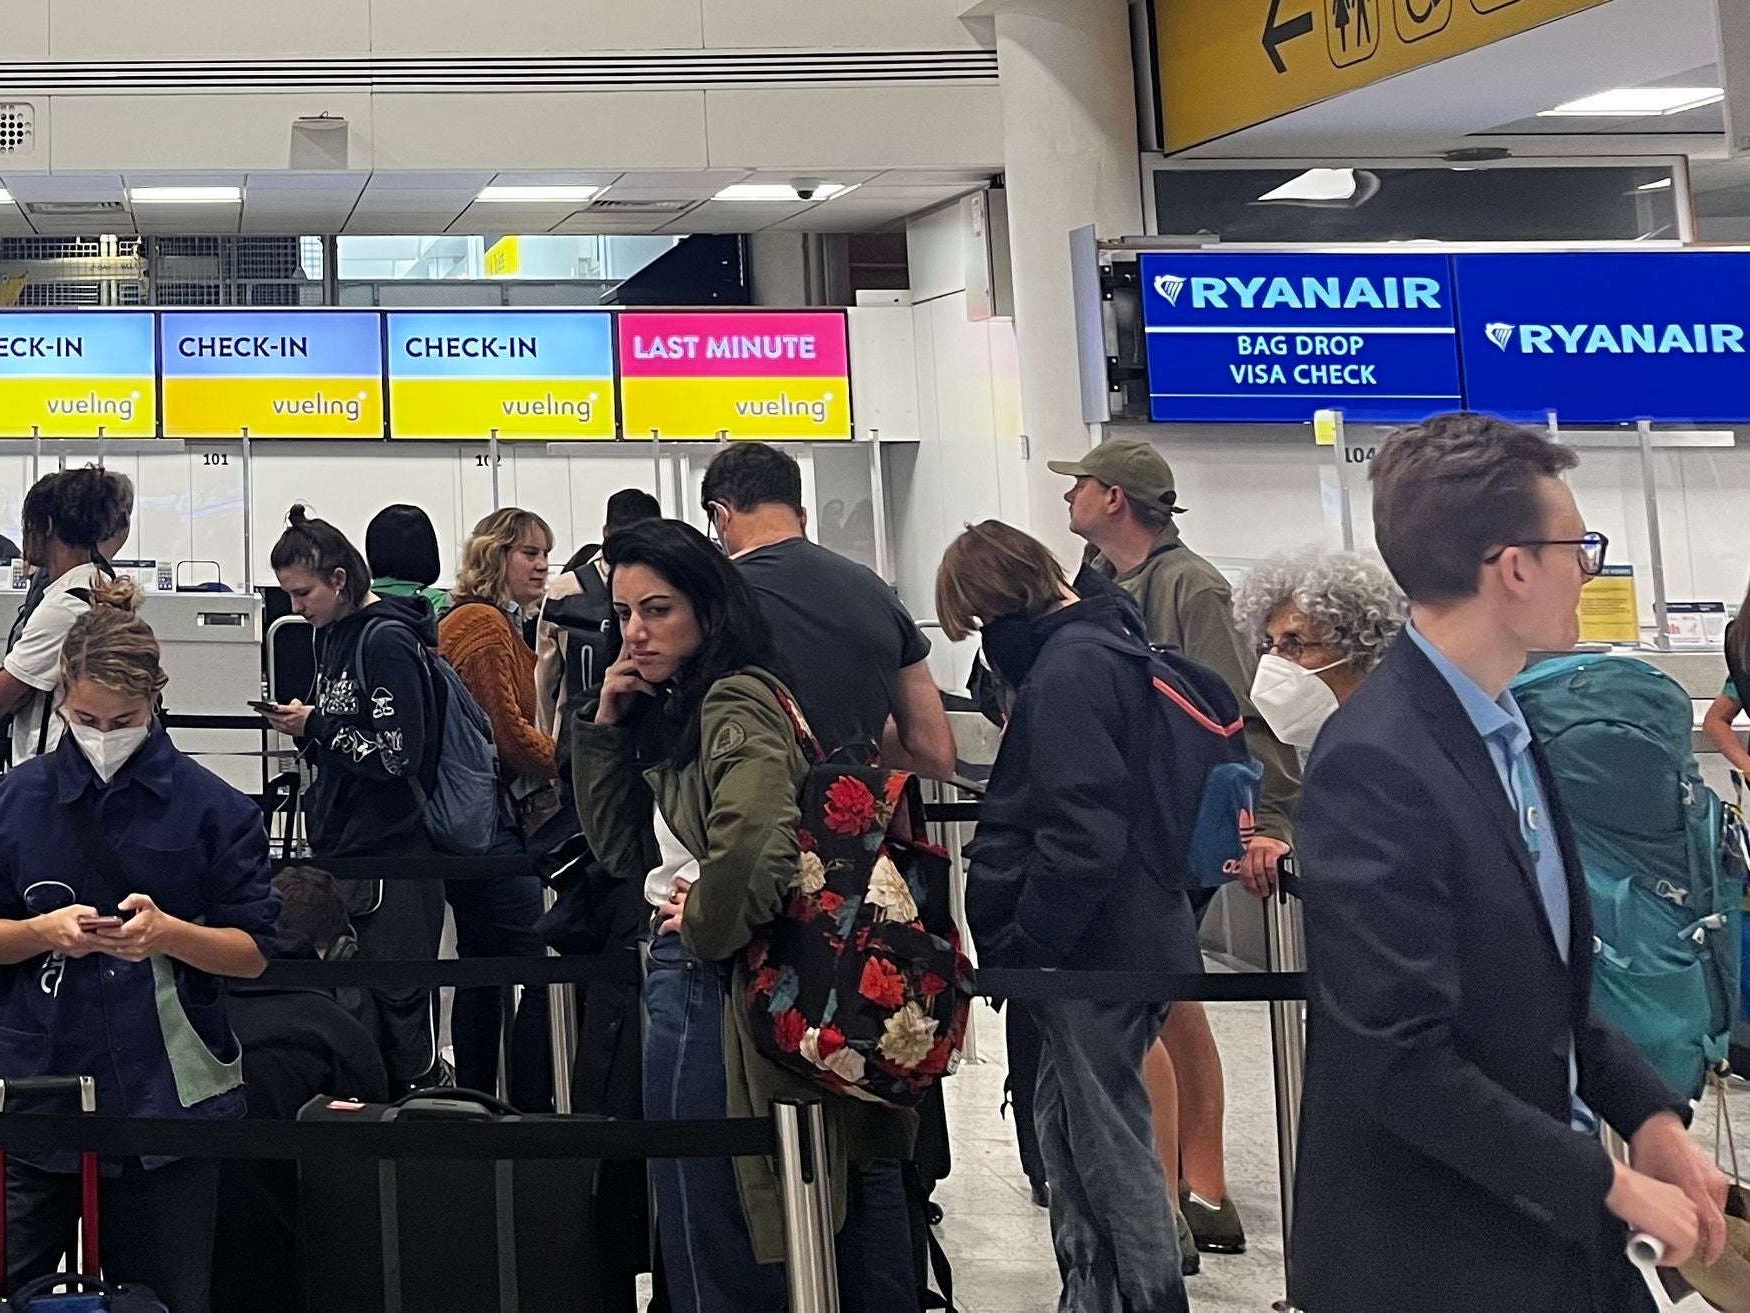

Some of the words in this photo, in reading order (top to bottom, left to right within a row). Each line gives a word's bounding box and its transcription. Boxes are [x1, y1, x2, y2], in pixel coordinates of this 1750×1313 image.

[1191, 276, 1441, 309] RYANAIR
[178, 336, 307, 358] CHECK-IN
[406, 336, 537, 359] CHECK-IN
[633, 335, 698, 360] LAST
[706, 335, 816, 360] MINUTE
[1238, 335, 1290, 357] BAG
[1295, 335, 1365, 356] DROP
[1520, 324, 1746, 354] RYANAIR
[1230, 364, 1287, 386] VISA
[1293, 364, 1377, 385] CHECK
[47, 392, 132, 421] vueling
[272, 392, 360, 422] vueling
[502, 392, 590, 423] vueling
[735, 392, 825, 423] vueling
[203, 453, 229, 466] 101
